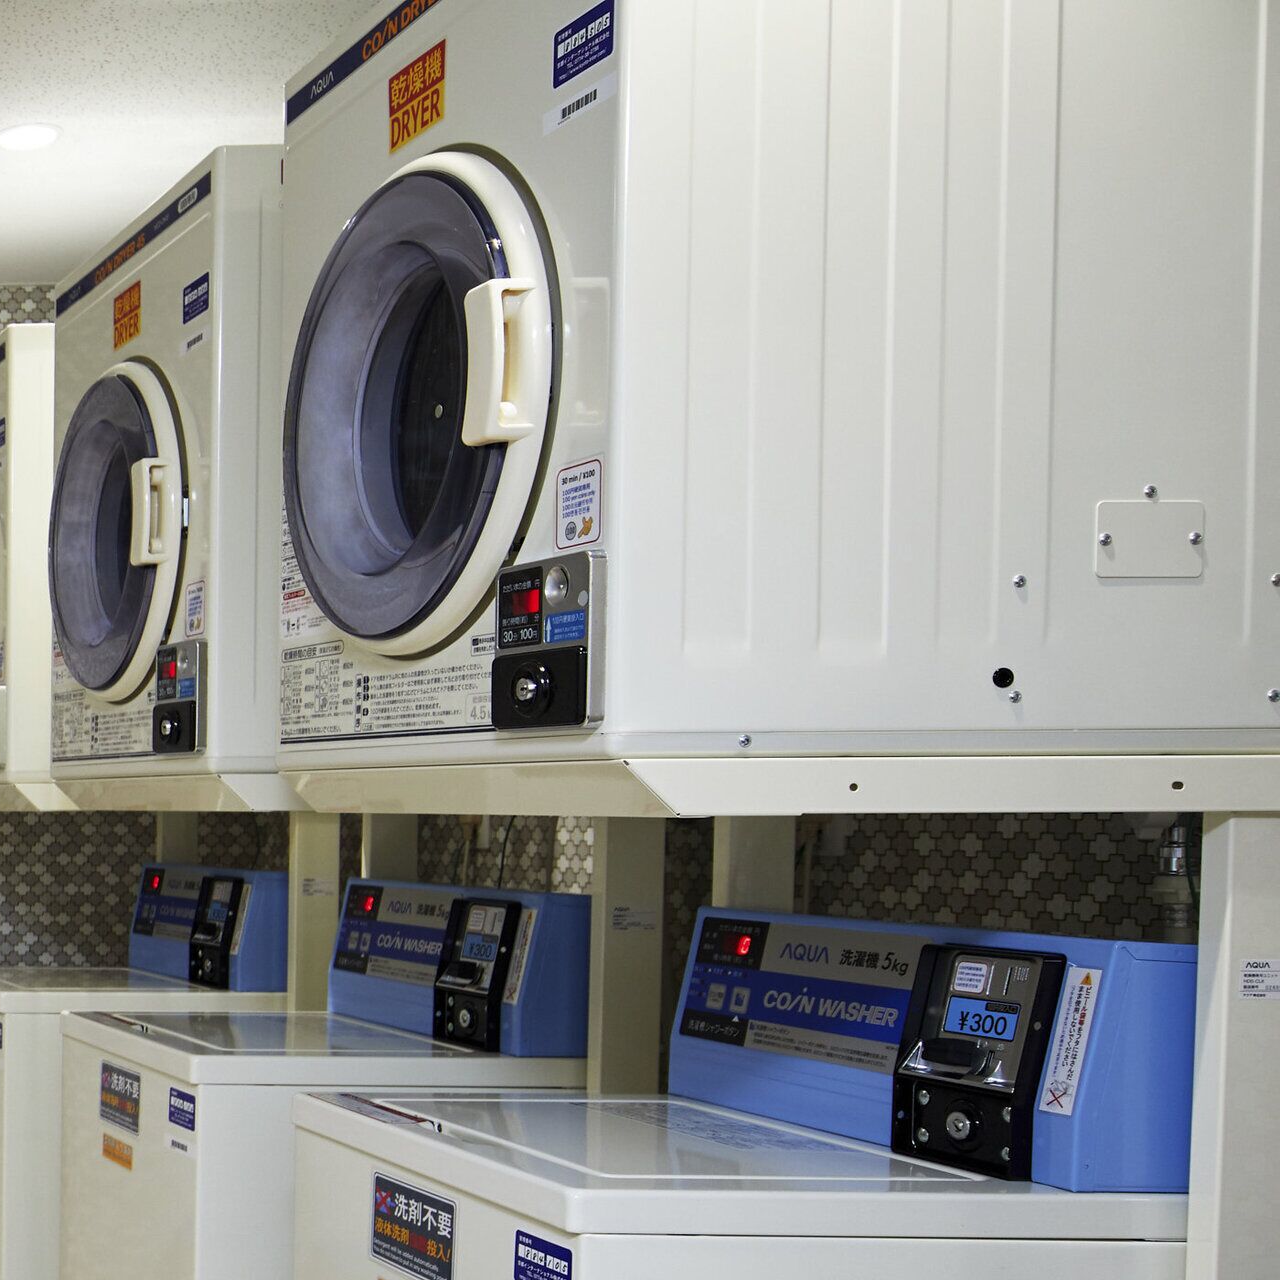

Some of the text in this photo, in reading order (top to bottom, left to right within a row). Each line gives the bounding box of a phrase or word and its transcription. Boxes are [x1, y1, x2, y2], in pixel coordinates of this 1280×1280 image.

[310, 16, 398, 99] AQUA COIN
[391, 48, 442, 109] 乾燥機
[391, 87, 440, 149] DRYER
[114, 313, 139, 349] DRYER
[561, 475, 568, 485] 30
[568, 473, 578, 484] min
[387, 900, 412, 914] AQUA
[377, 930, 443, 956] COIN WASHER
[780, 943, 909, 976] AQUA 洗濯機 5kg
[1245, 961, 1271, 969] AQUA
[763, 986, 900, 1028] COIN WASHER
[958, 1010, 1007, 1036] ¥300
[394, 1193, 452, 1239] 洗剤不要
